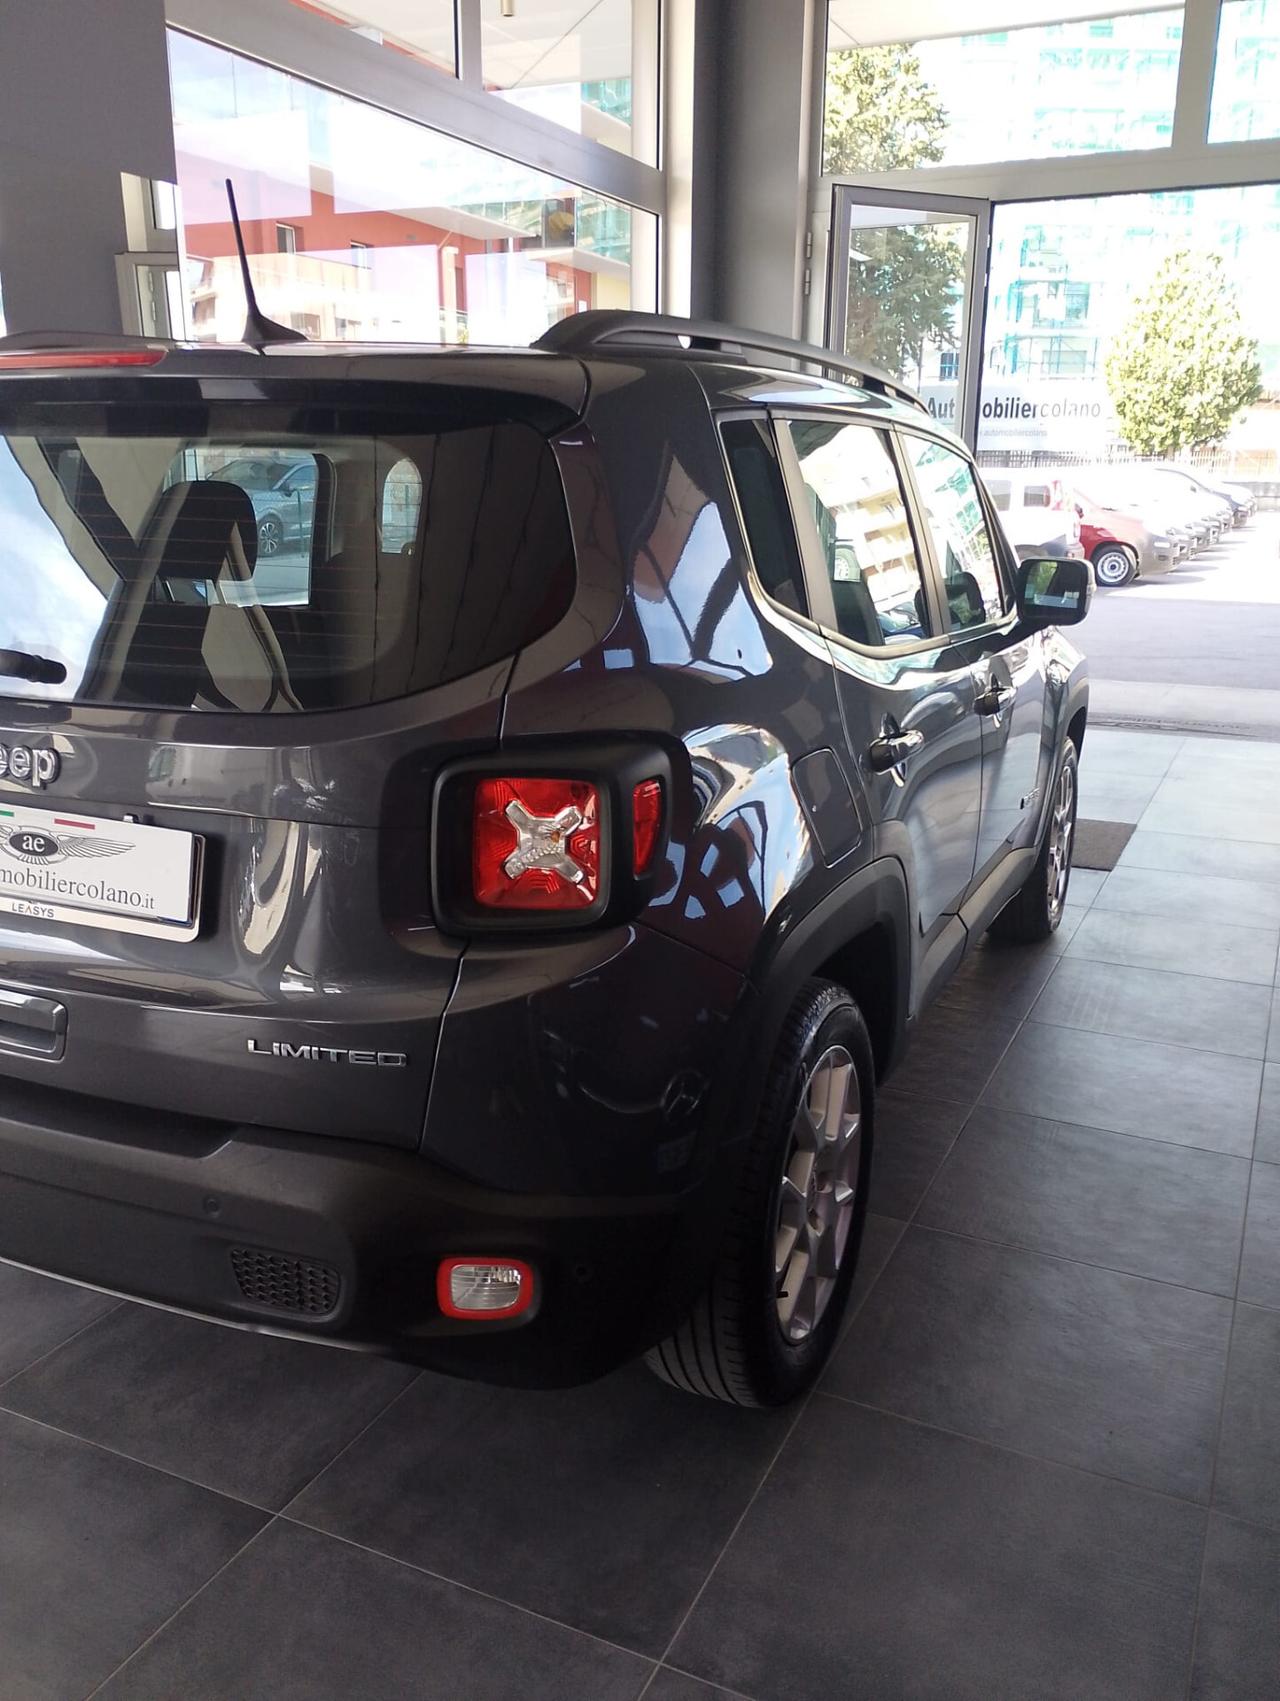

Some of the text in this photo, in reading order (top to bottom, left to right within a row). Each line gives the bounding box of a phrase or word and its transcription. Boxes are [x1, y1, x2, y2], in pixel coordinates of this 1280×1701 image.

[22, 834, 45, 852] ae
[11, 902, 54, 918] LEASYS
[247, 1039, 407, 1067] LIMITED
